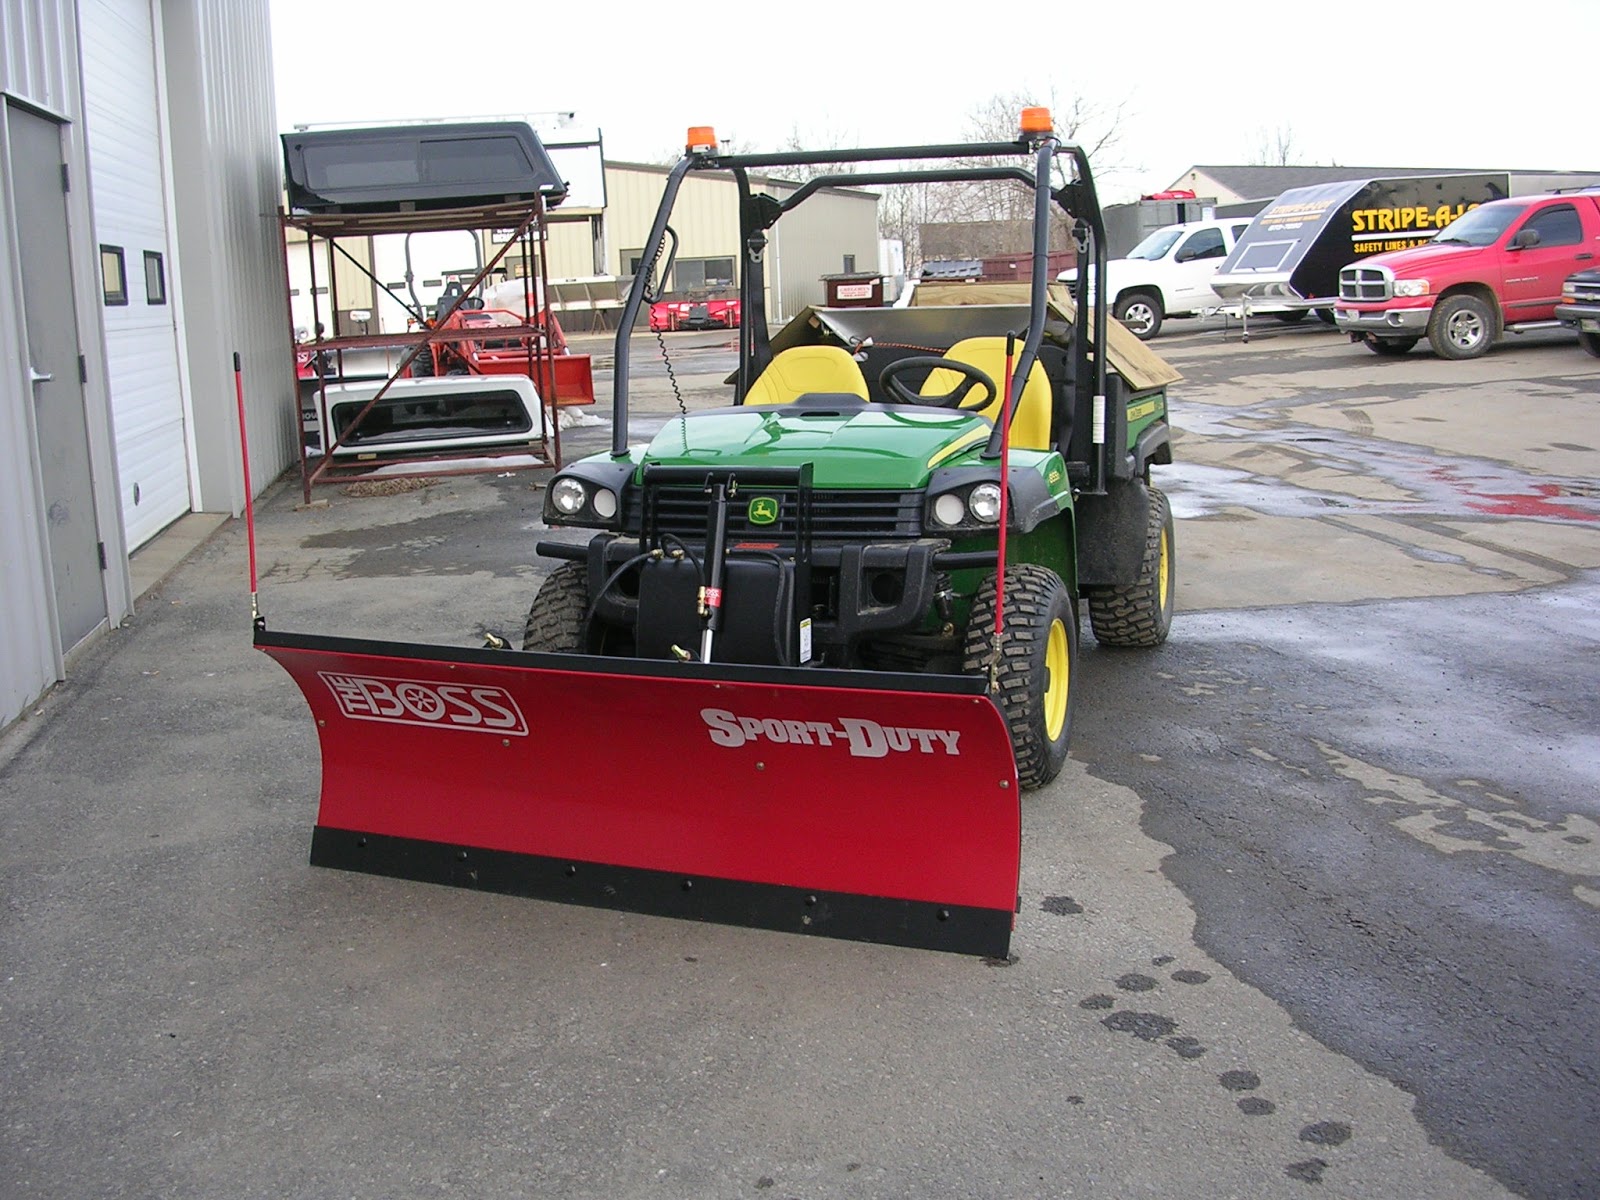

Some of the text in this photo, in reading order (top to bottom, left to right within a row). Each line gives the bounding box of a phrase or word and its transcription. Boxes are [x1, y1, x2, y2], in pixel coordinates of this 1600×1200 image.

[1352, 203, 1480, 231] STRIPE-A-
[1354, 241, 1382, 253] SAFETY
[1385, 240, 1406, 251] LINES
[327, 675, 516, 728] THE BOSS
[700, 708, 960, 758] SPORT-DUTY
